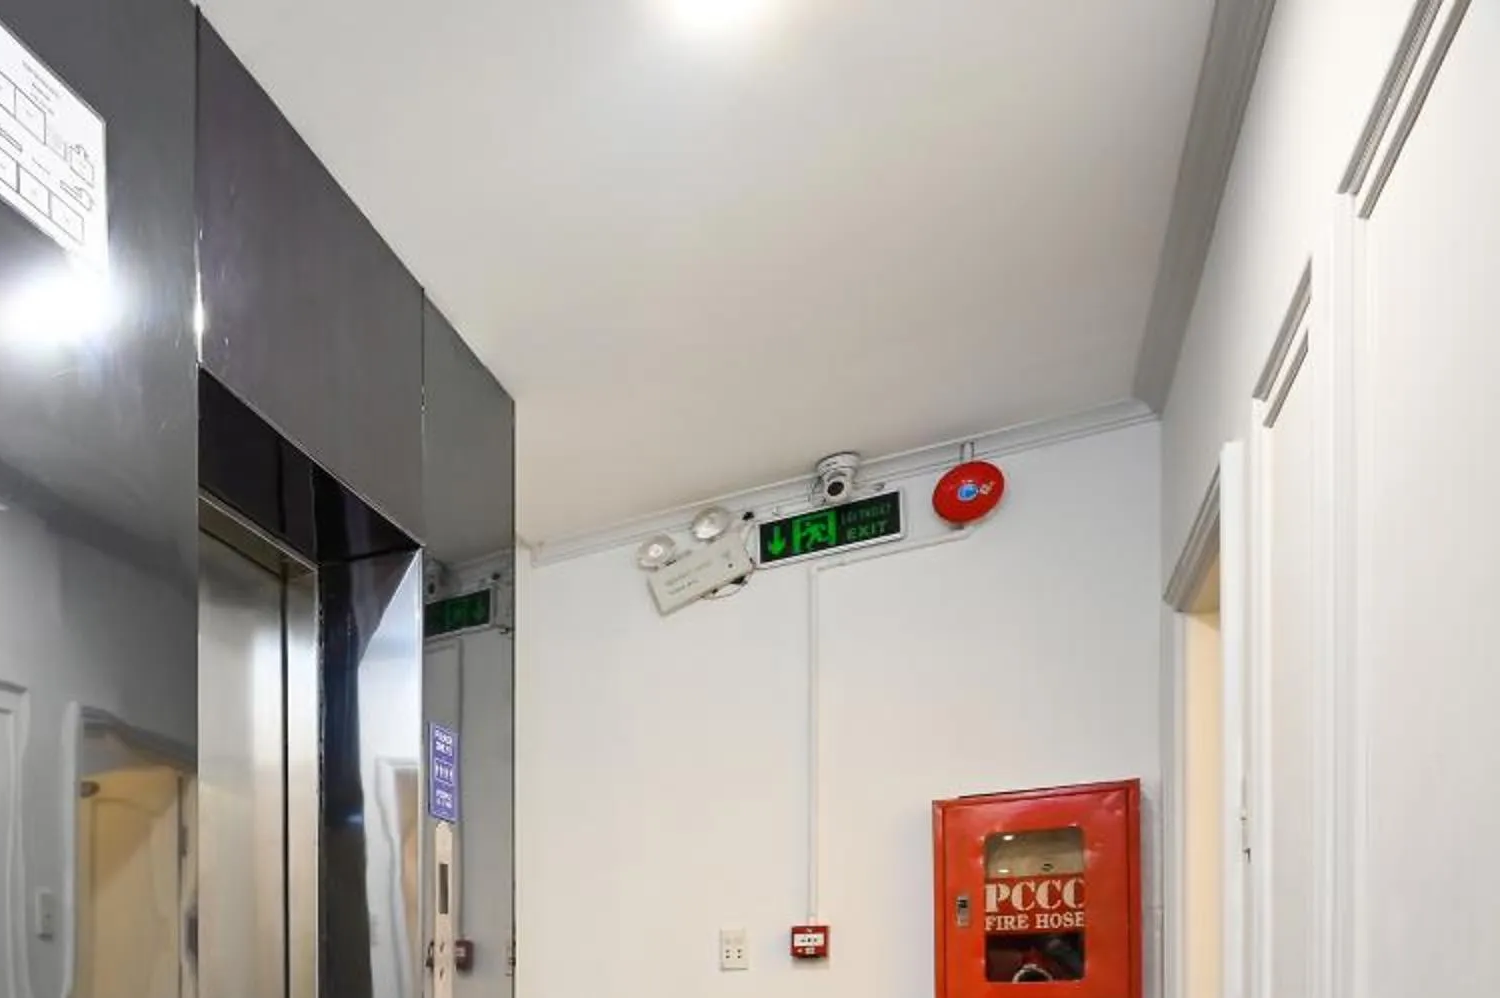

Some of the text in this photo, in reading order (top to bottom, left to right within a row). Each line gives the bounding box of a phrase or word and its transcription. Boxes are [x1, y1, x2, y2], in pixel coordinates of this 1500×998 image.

[846, 519, 888, 540] EXIT
[984, 878, 1085, 913] PCCC
[984, 912, 1085, 931] FIRE HOSE
